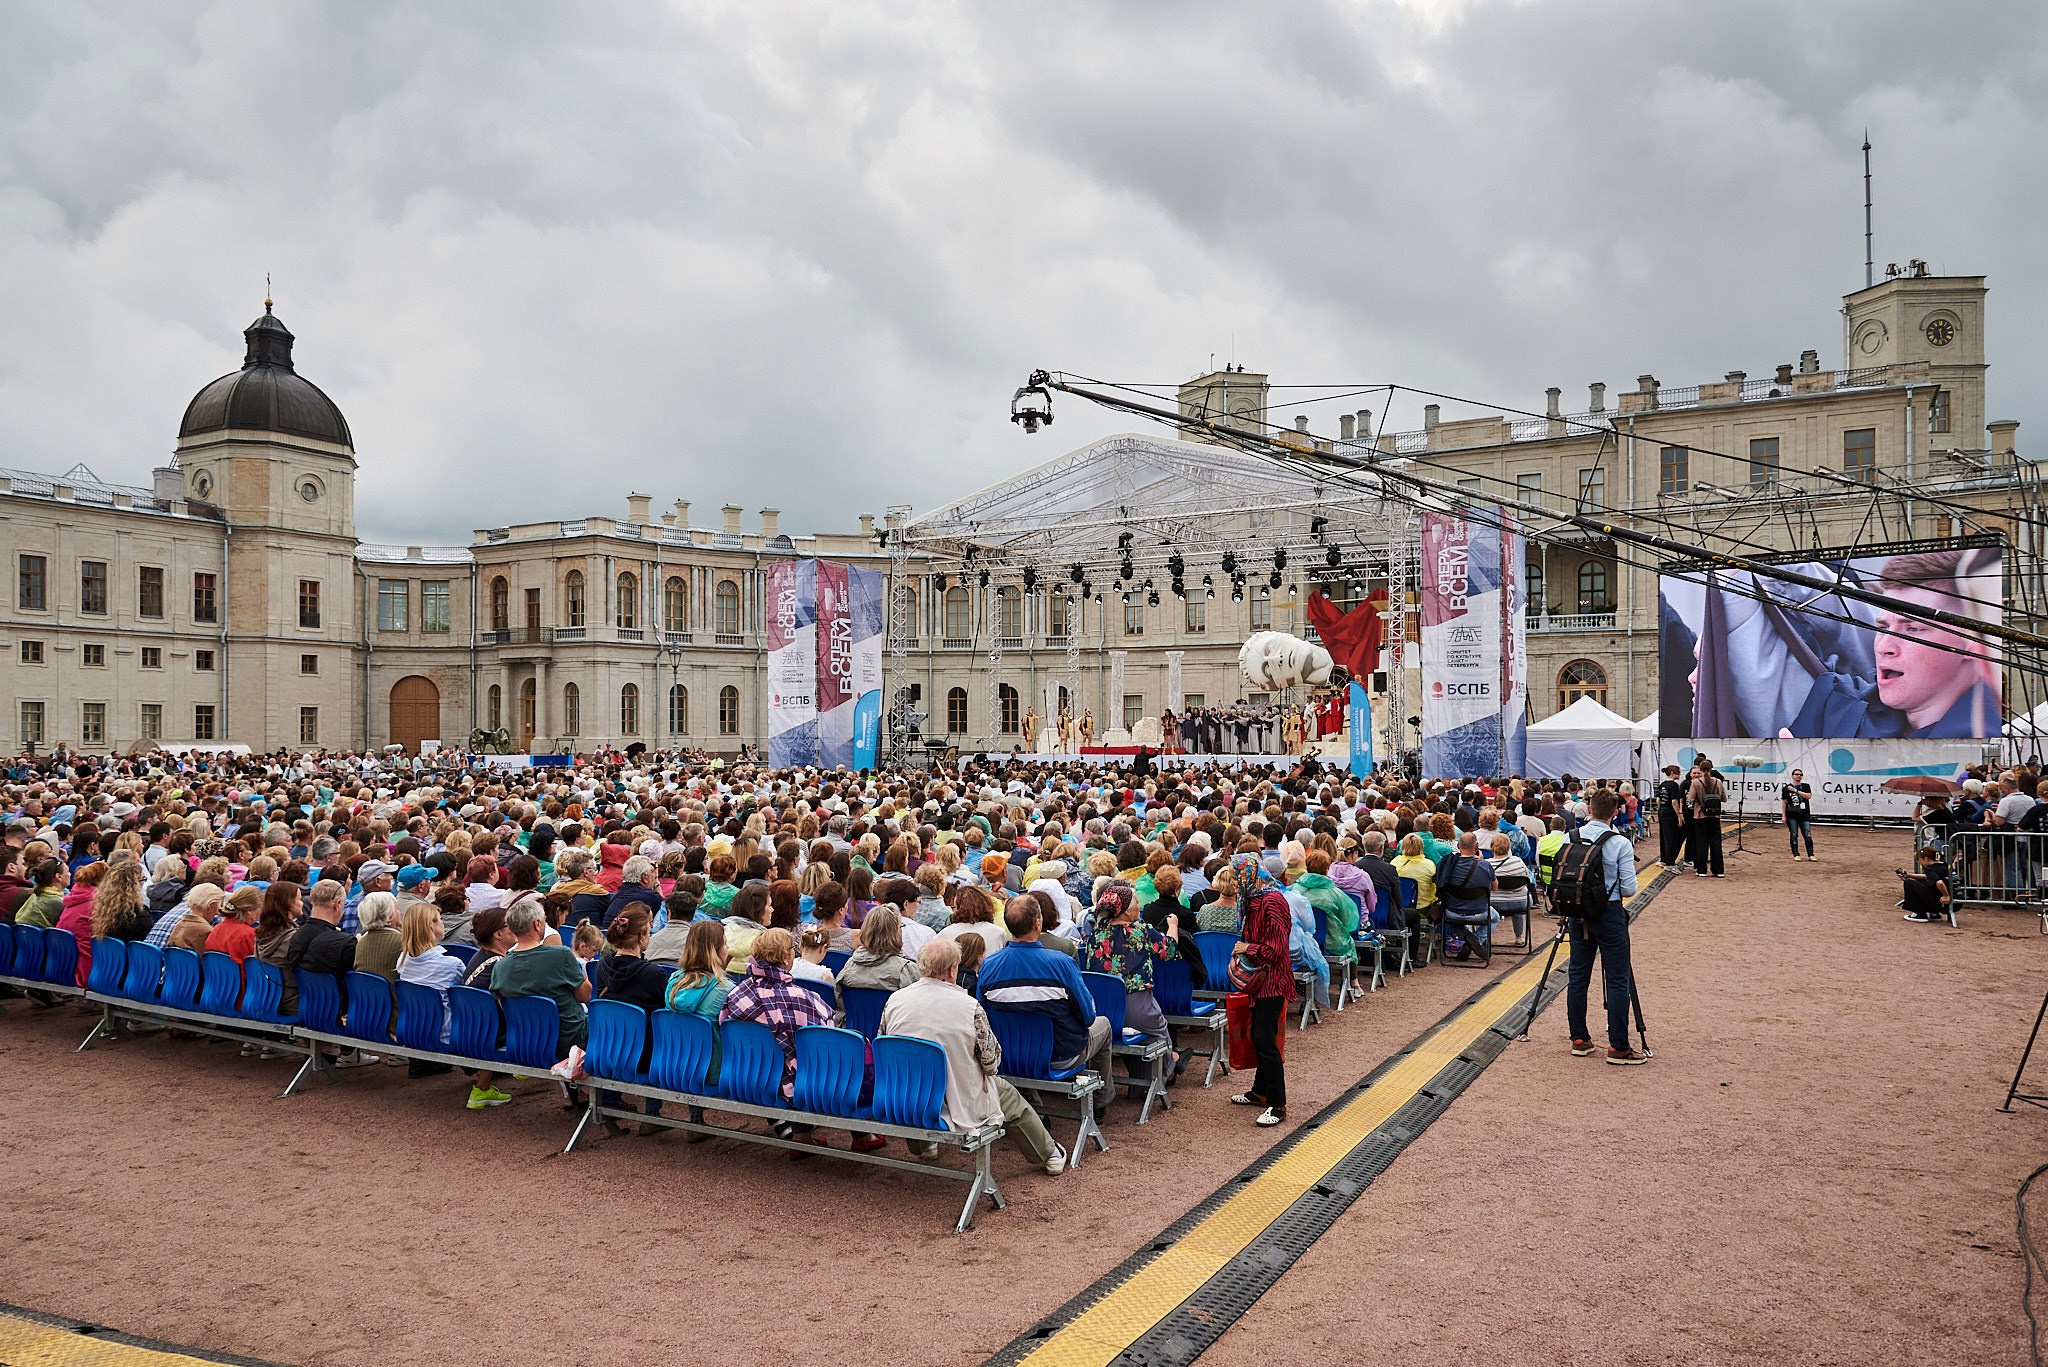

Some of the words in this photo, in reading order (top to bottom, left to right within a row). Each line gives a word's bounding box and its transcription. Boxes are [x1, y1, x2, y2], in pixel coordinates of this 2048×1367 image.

[1449, 545, 1468, 610] ВСЕМ
[784, 589, 796, 639] ВСЕМ
[839, 617, 853, 694] ВСЕМ
[1447, 683, 1490, 695] БСПБ
[782, 695, 810, 705] БСПБ
[1723, 779, 1788, 792] ПЕТЕРБУР
[1823, 797, 1911, 805] ТЕЛЕКА
